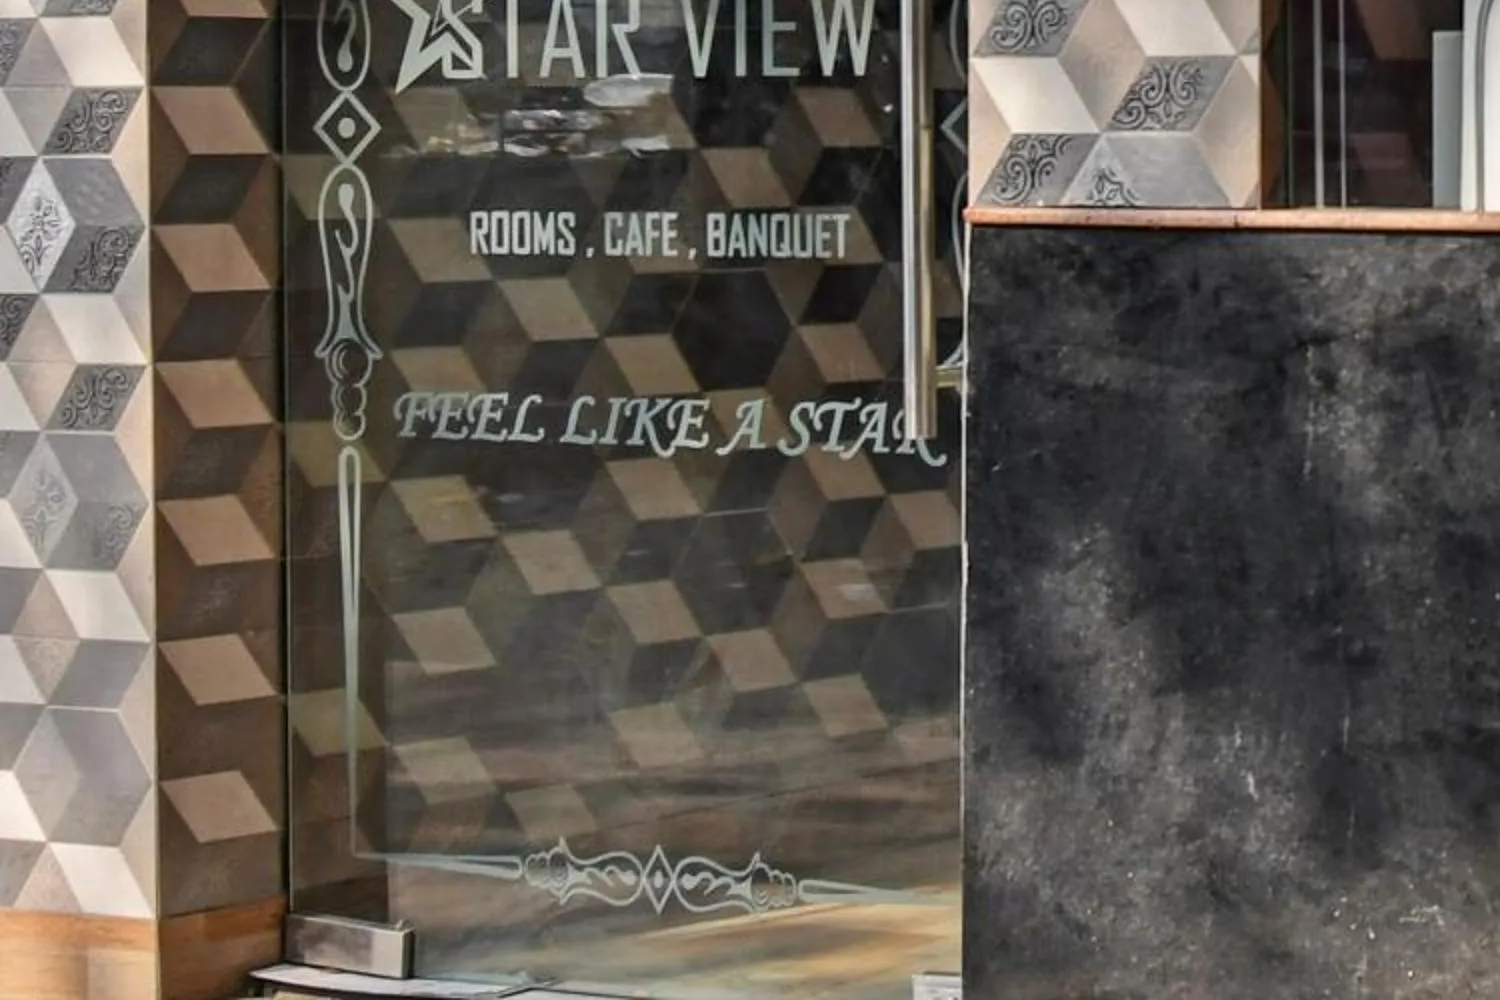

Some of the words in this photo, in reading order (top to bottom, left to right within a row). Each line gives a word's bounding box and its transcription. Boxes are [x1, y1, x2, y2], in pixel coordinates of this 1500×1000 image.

[706, 212, 851, 260] BANQUET
[393, 390, 545, 442] FEEL
[559, 394, 709, 457] LIKE
[716, 396, 763, 457] A
